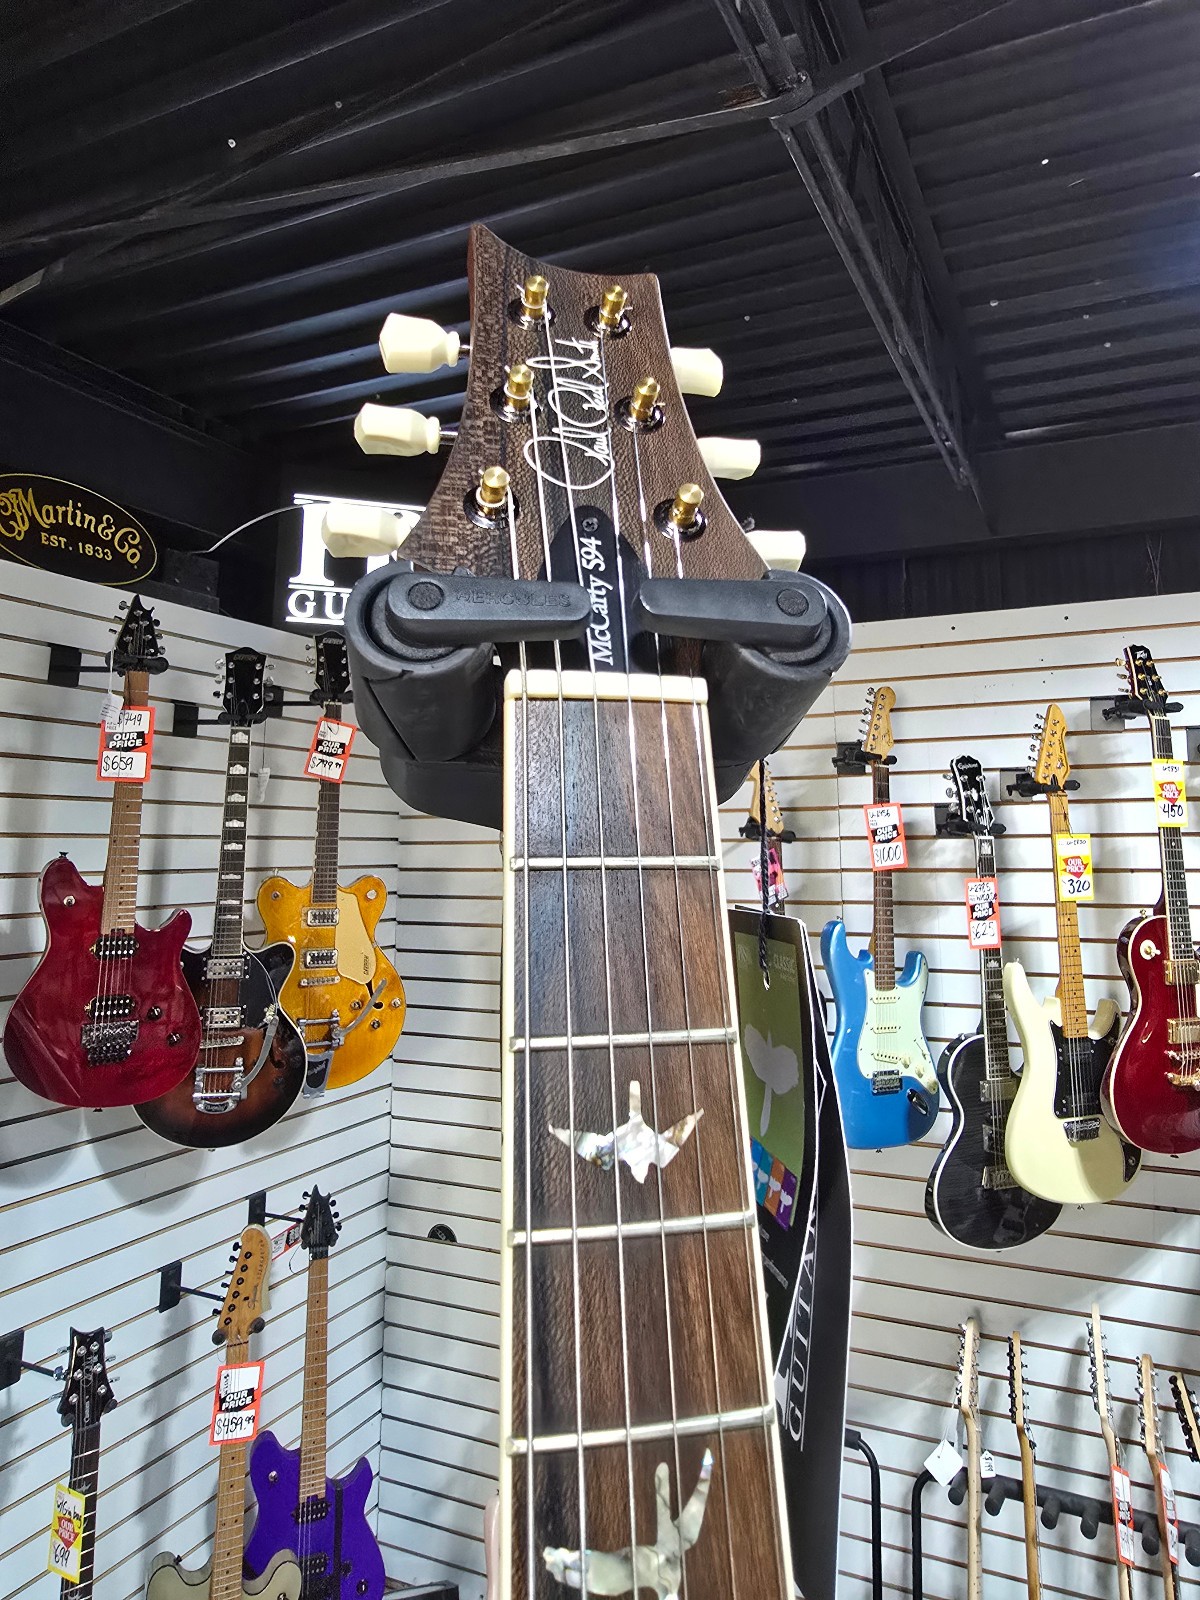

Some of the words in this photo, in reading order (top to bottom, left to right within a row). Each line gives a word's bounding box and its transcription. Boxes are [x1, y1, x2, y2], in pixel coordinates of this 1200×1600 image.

[41, 531, 73, 551] EST.
[78, 541, 113, 561] 1833
[454, 588, 572, 608] HERCULES
[113, 732, 138, 741] OUR
[109, 739, 143, 749] PRICE
[322, 740, 341, 749] OUR
[317, 746, 344, 755] PRICE
[103, 755, 134, 772] $659
[1163, 783, 1177, 792] OUR
[1161, 790, 1179, 799] PRICE
[1162, 803, 1184, 819] 450
[874, 831, 898, 843] PRICE
[876, 825, 894, 837] OUR
[874, 844, 902, 865] $1000
[1066, 864, 1085, 873] PRICE
[1067, 858, 1083, 867] OUR
[1067, 878, 1091, 894] 320
[974, 902, 990, 912] OUR
[972, 907, 993, 920] PRICE
[225, 1390, 248, 1403] OUR
[221, 1395, 253, 1411] PRICE
[61, 1518, 74, 1532] OUR
[58, 1527, 76, 1543] PRICE
